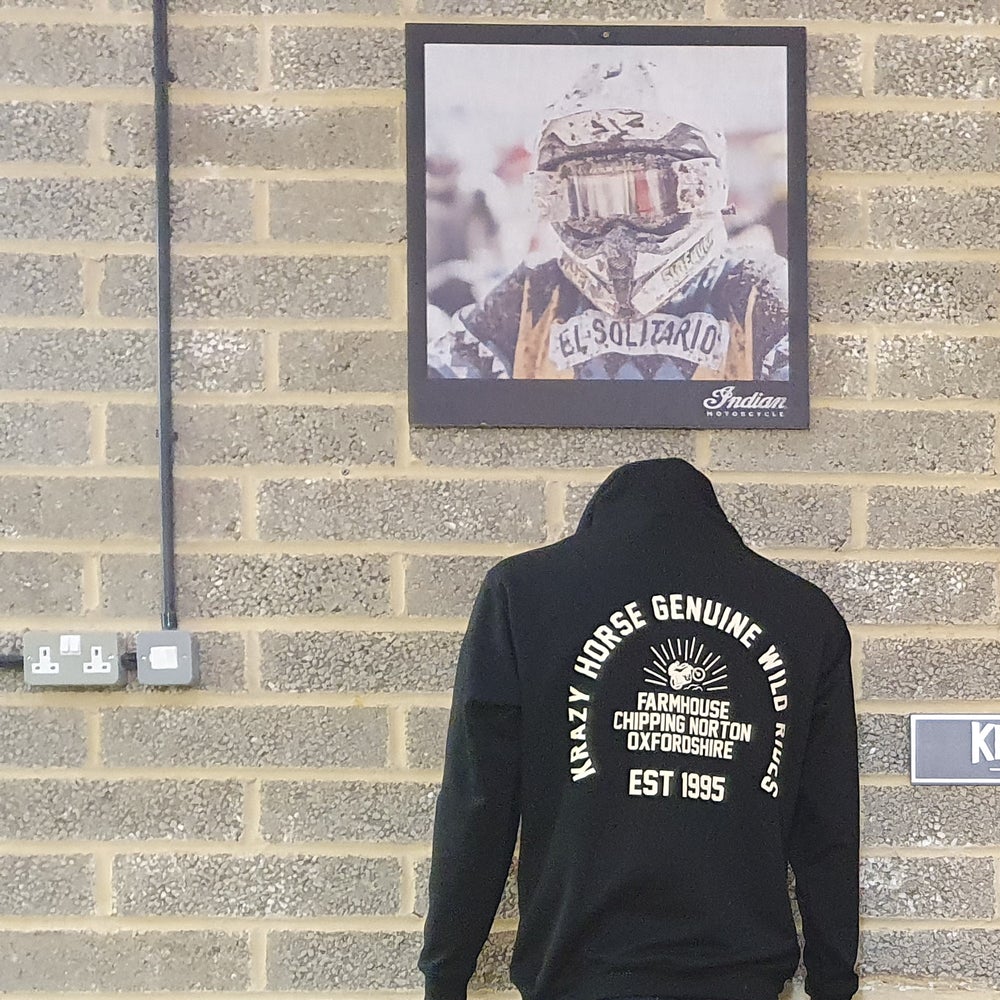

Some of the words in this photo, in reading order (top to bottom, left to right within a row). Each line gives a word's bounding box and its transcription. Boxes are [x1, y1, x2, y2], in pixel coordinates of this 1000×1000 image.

[558, 324, 588, 358] EL
[591, 318, 717, 355] SOLITARIO
[703, 385, 788, 409] Indian
[574, 601, 647, 679] HORSE
[651, 594, 763, 649] GENUINE
[757, 645, 789, 712] WILD
[637, 691, 730, 720] FARMHOUSE
[568, 685, 597, 782] KRAZY
[613, 711, 686, 733] CHIPPING
[689, 718, 752, 742] NORTON
[627, 731, 735, 760] OXFORDSHIRE
[629, 768, 674, 797] EST
[681, 772, 726, 802] 1995
